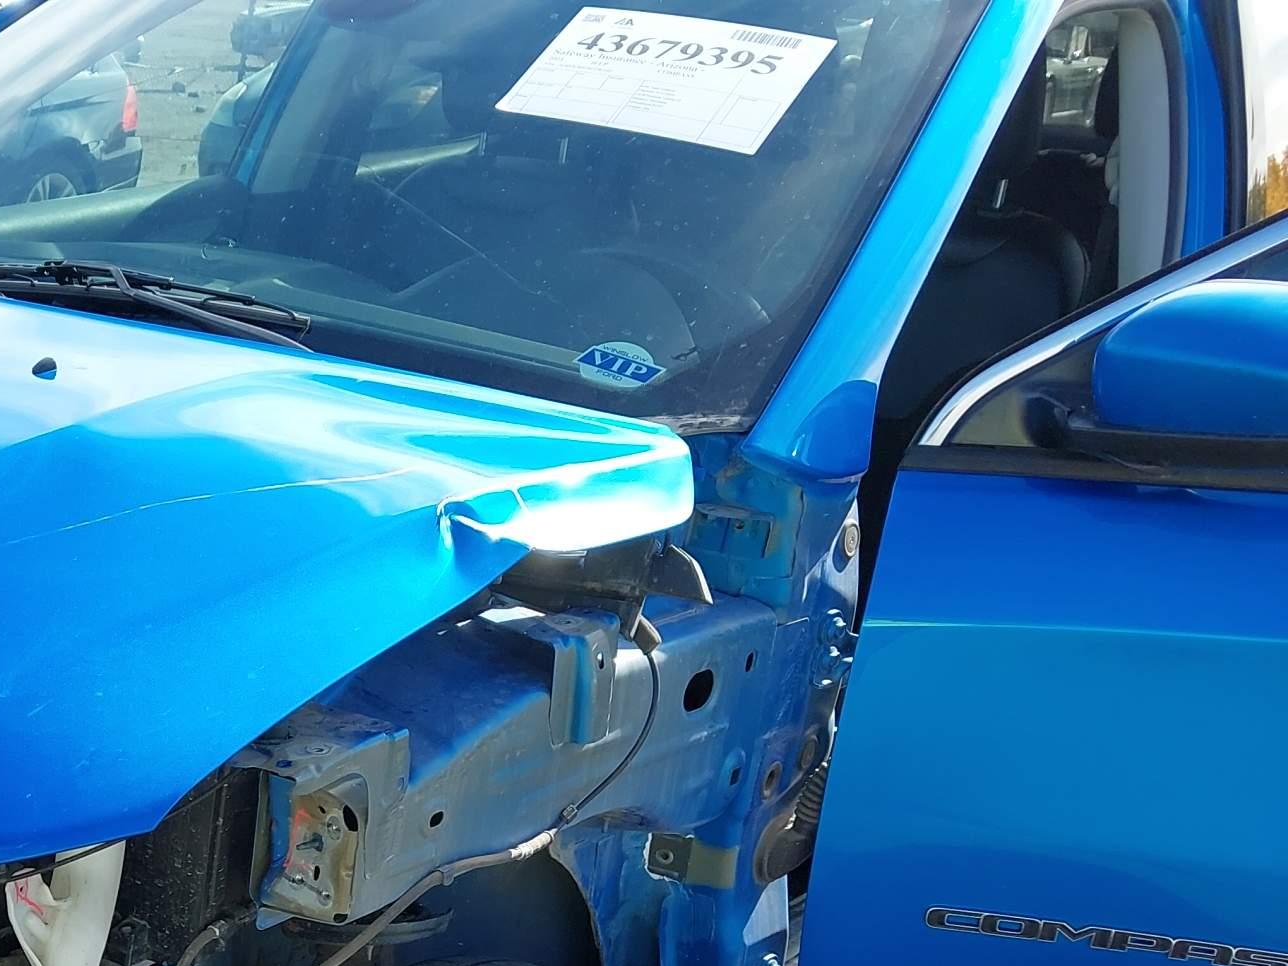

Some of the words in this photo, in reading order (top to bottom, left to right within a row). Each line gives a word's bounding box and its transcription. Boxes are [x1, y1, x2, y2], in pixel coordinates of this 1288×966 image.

[577, 32, 784, 75] 43679395
[593, 349, 648, 376] VIP
[602, 344, 649, 362] WINSLOW
[595, 368, 623, 382] FORD
